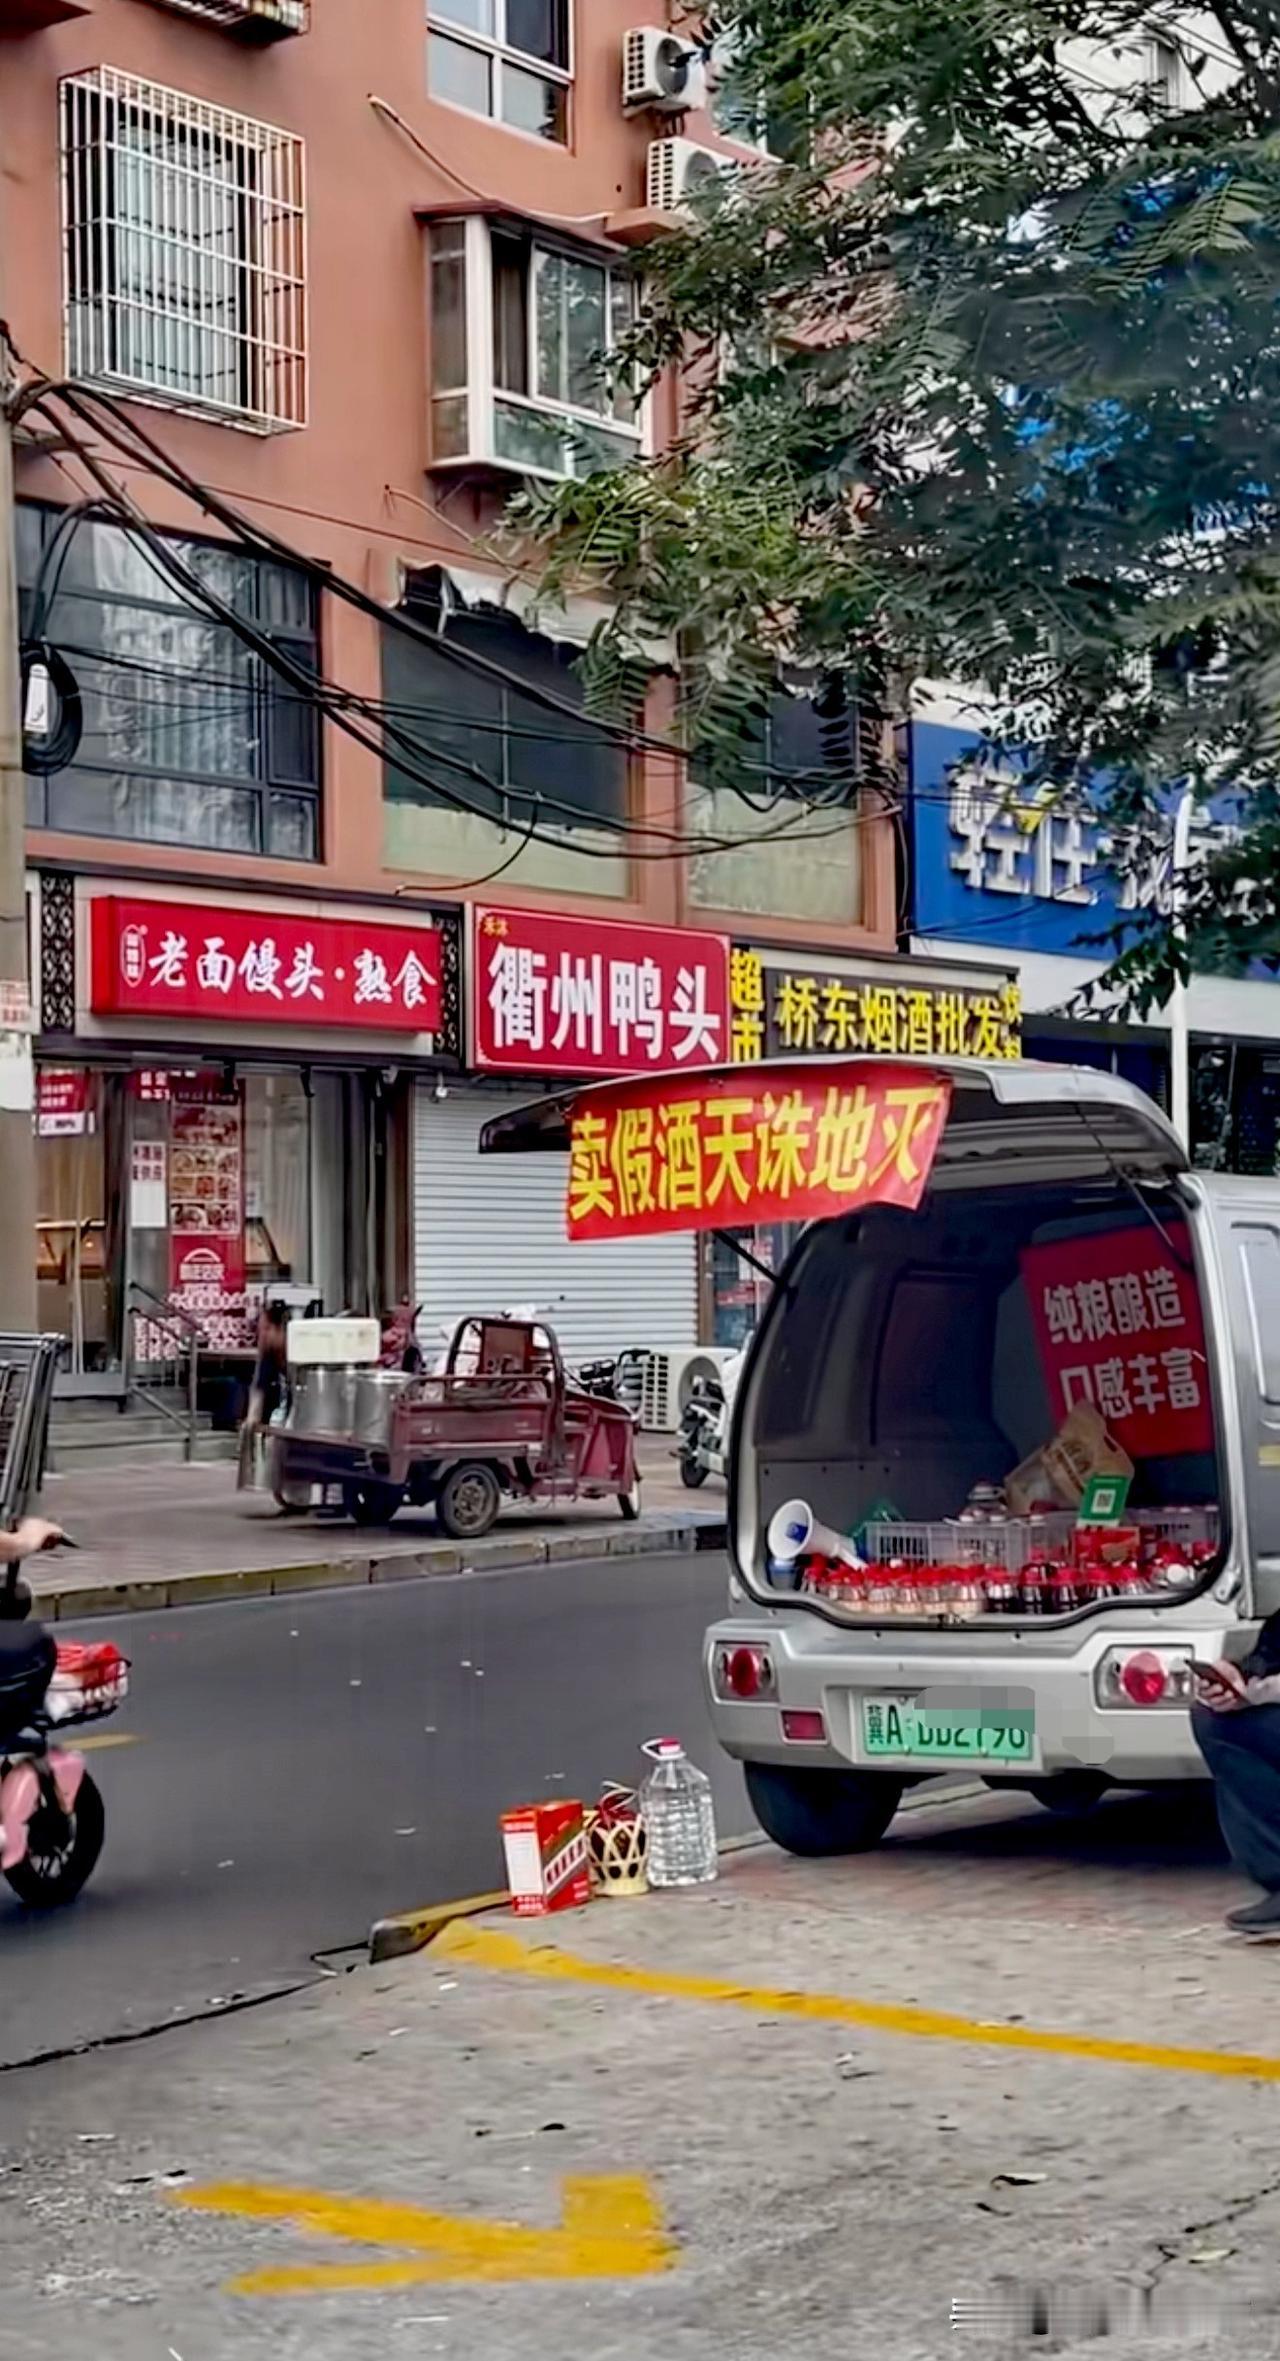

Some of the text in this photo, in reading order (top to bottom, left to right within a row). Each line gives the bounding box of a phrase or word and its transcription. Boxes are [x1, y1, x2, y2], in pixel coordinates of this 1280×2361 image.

[488, 941, 721, 1061] 衢州鸭头
[731, 948, 764, 1062] 超市
[775, 974, 1003, 1059] 桥东烟酒批发
[569, 1085, 945, 1220] 卖假酒天诛地灭
[1043, 1266, 1186, 1344] 纯粮酿造
[1059, 1347, 1201, 1418] 口感丰富
